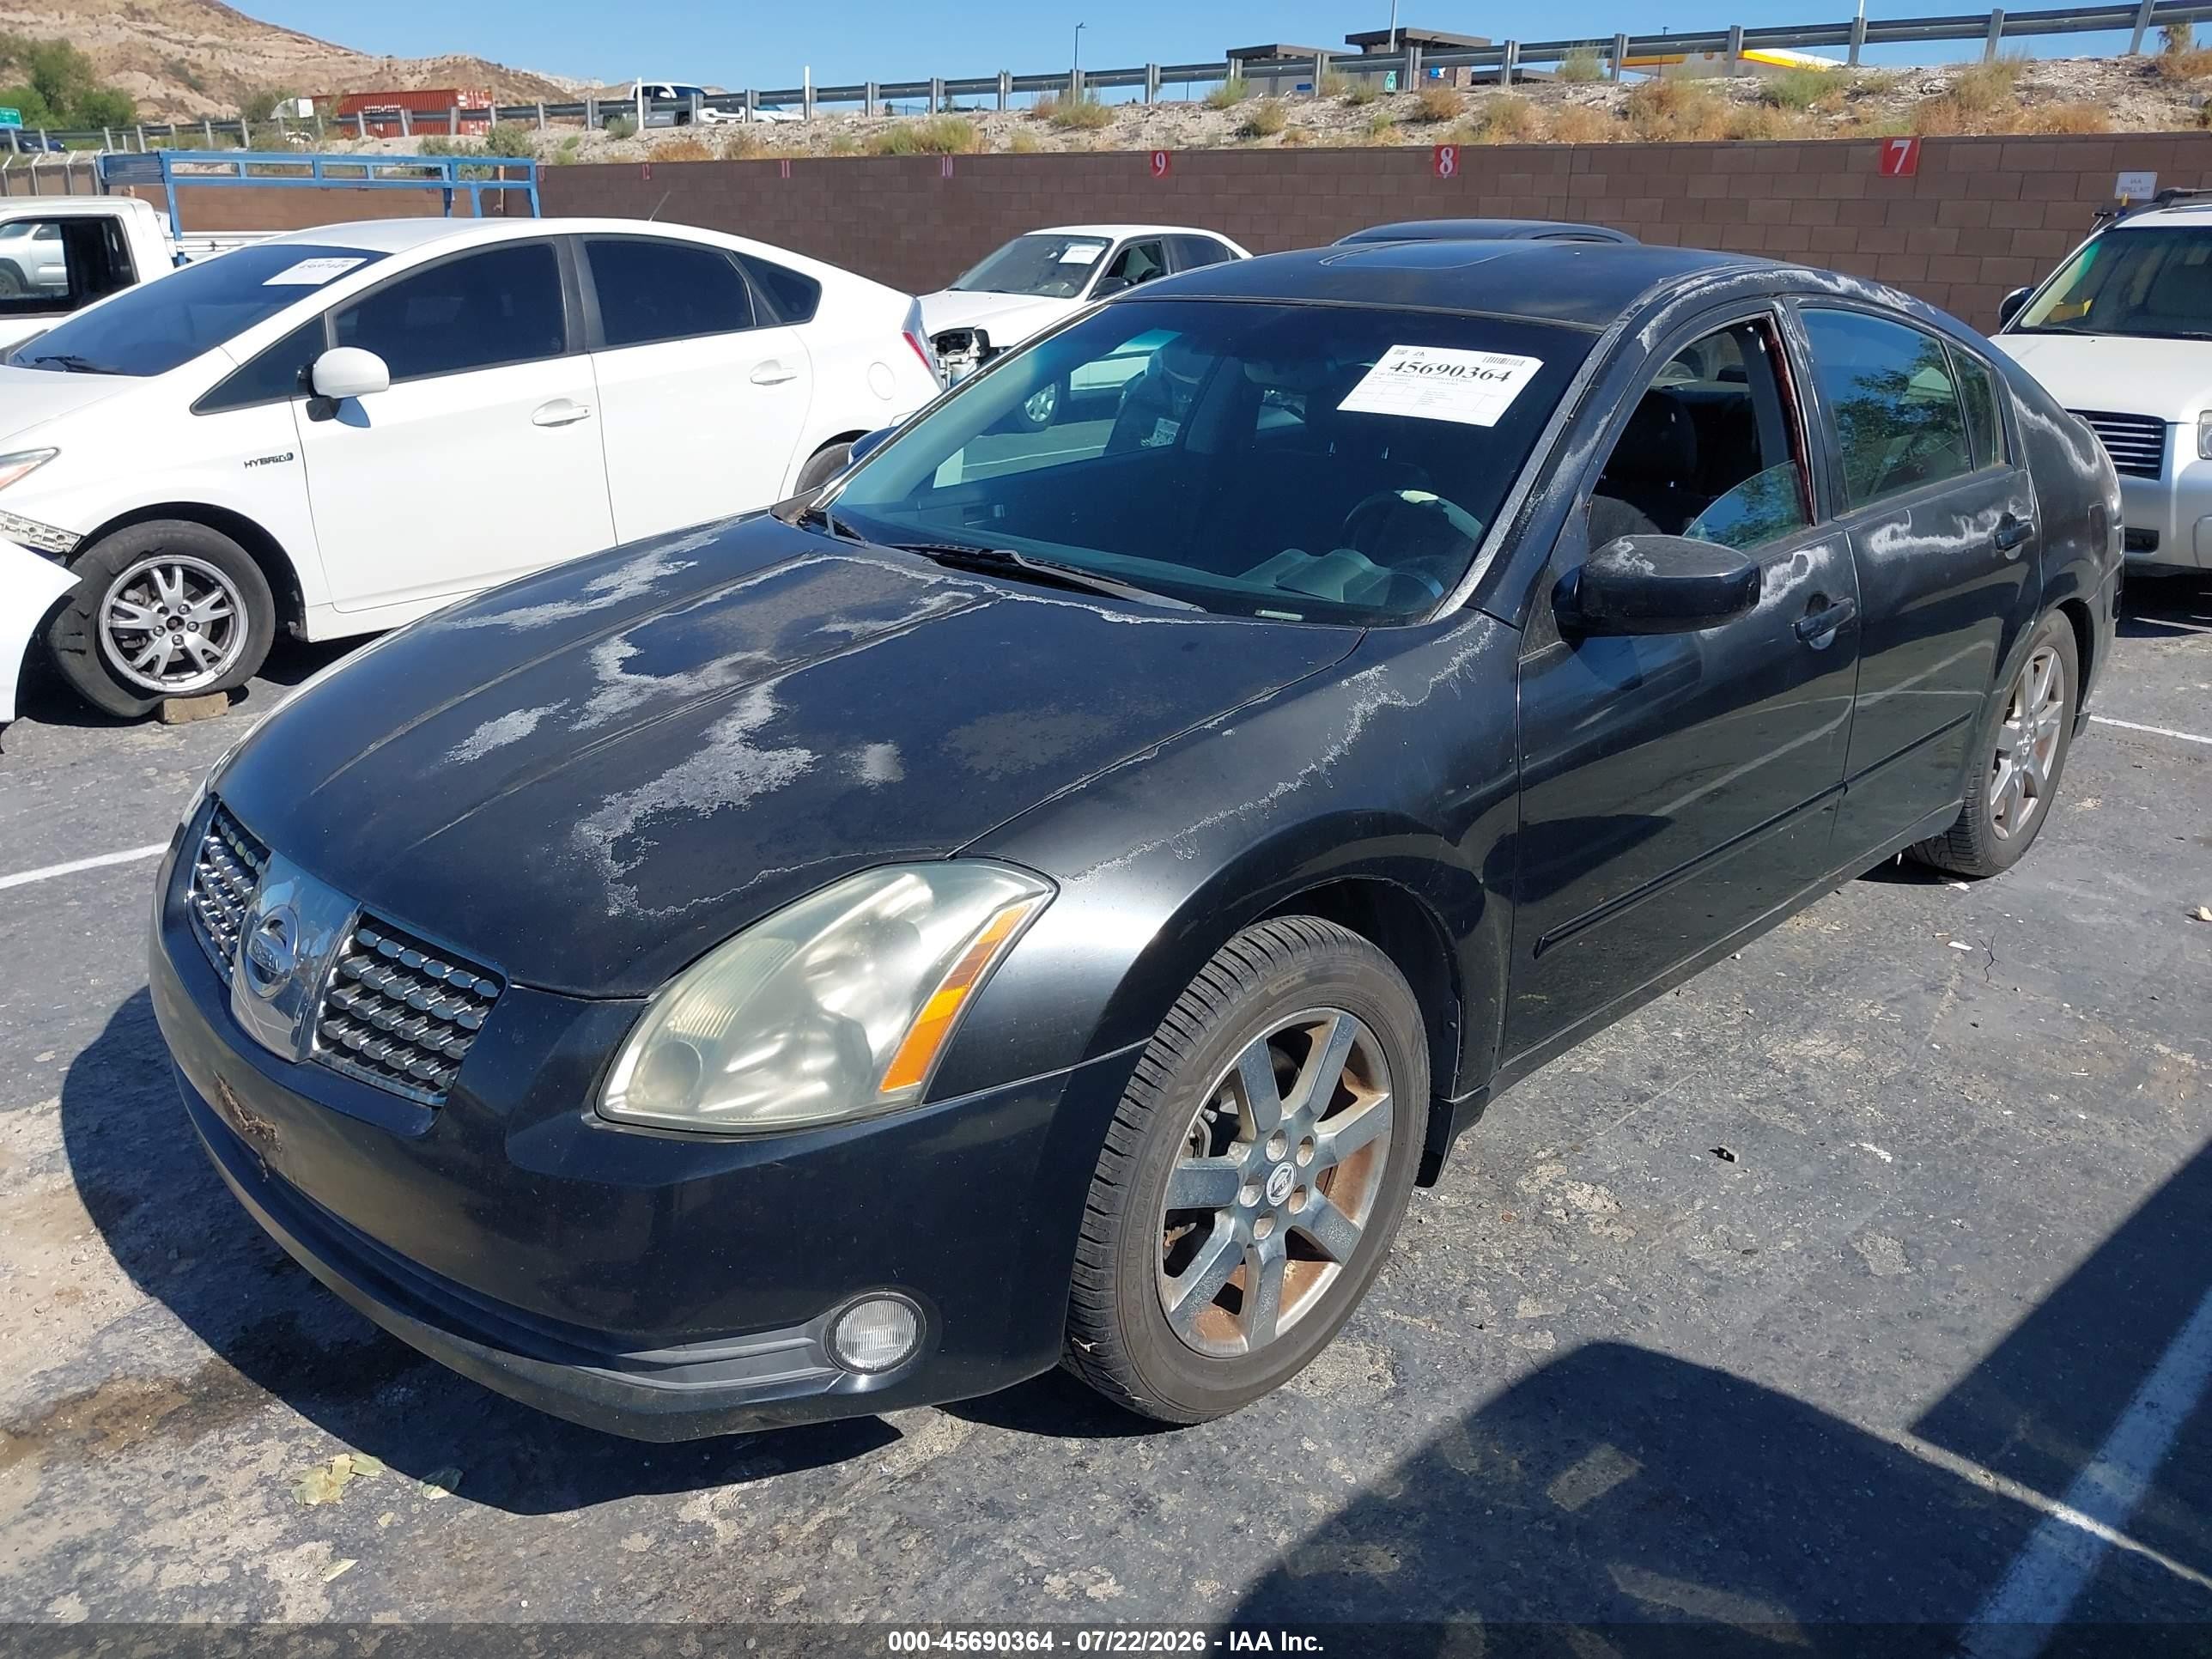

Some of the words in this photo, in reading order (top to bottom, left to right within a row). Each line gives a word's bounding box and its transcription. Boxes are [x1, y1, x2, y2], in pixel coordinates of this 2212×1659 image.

[942, 155, 953, 177] 10
[1155, 152, 1166, 176] 9
[1439, 147, 1454, 174] 8
[1890, 140, 1911, 173] 7
[1389, 361, 1513, 382] 45690364
